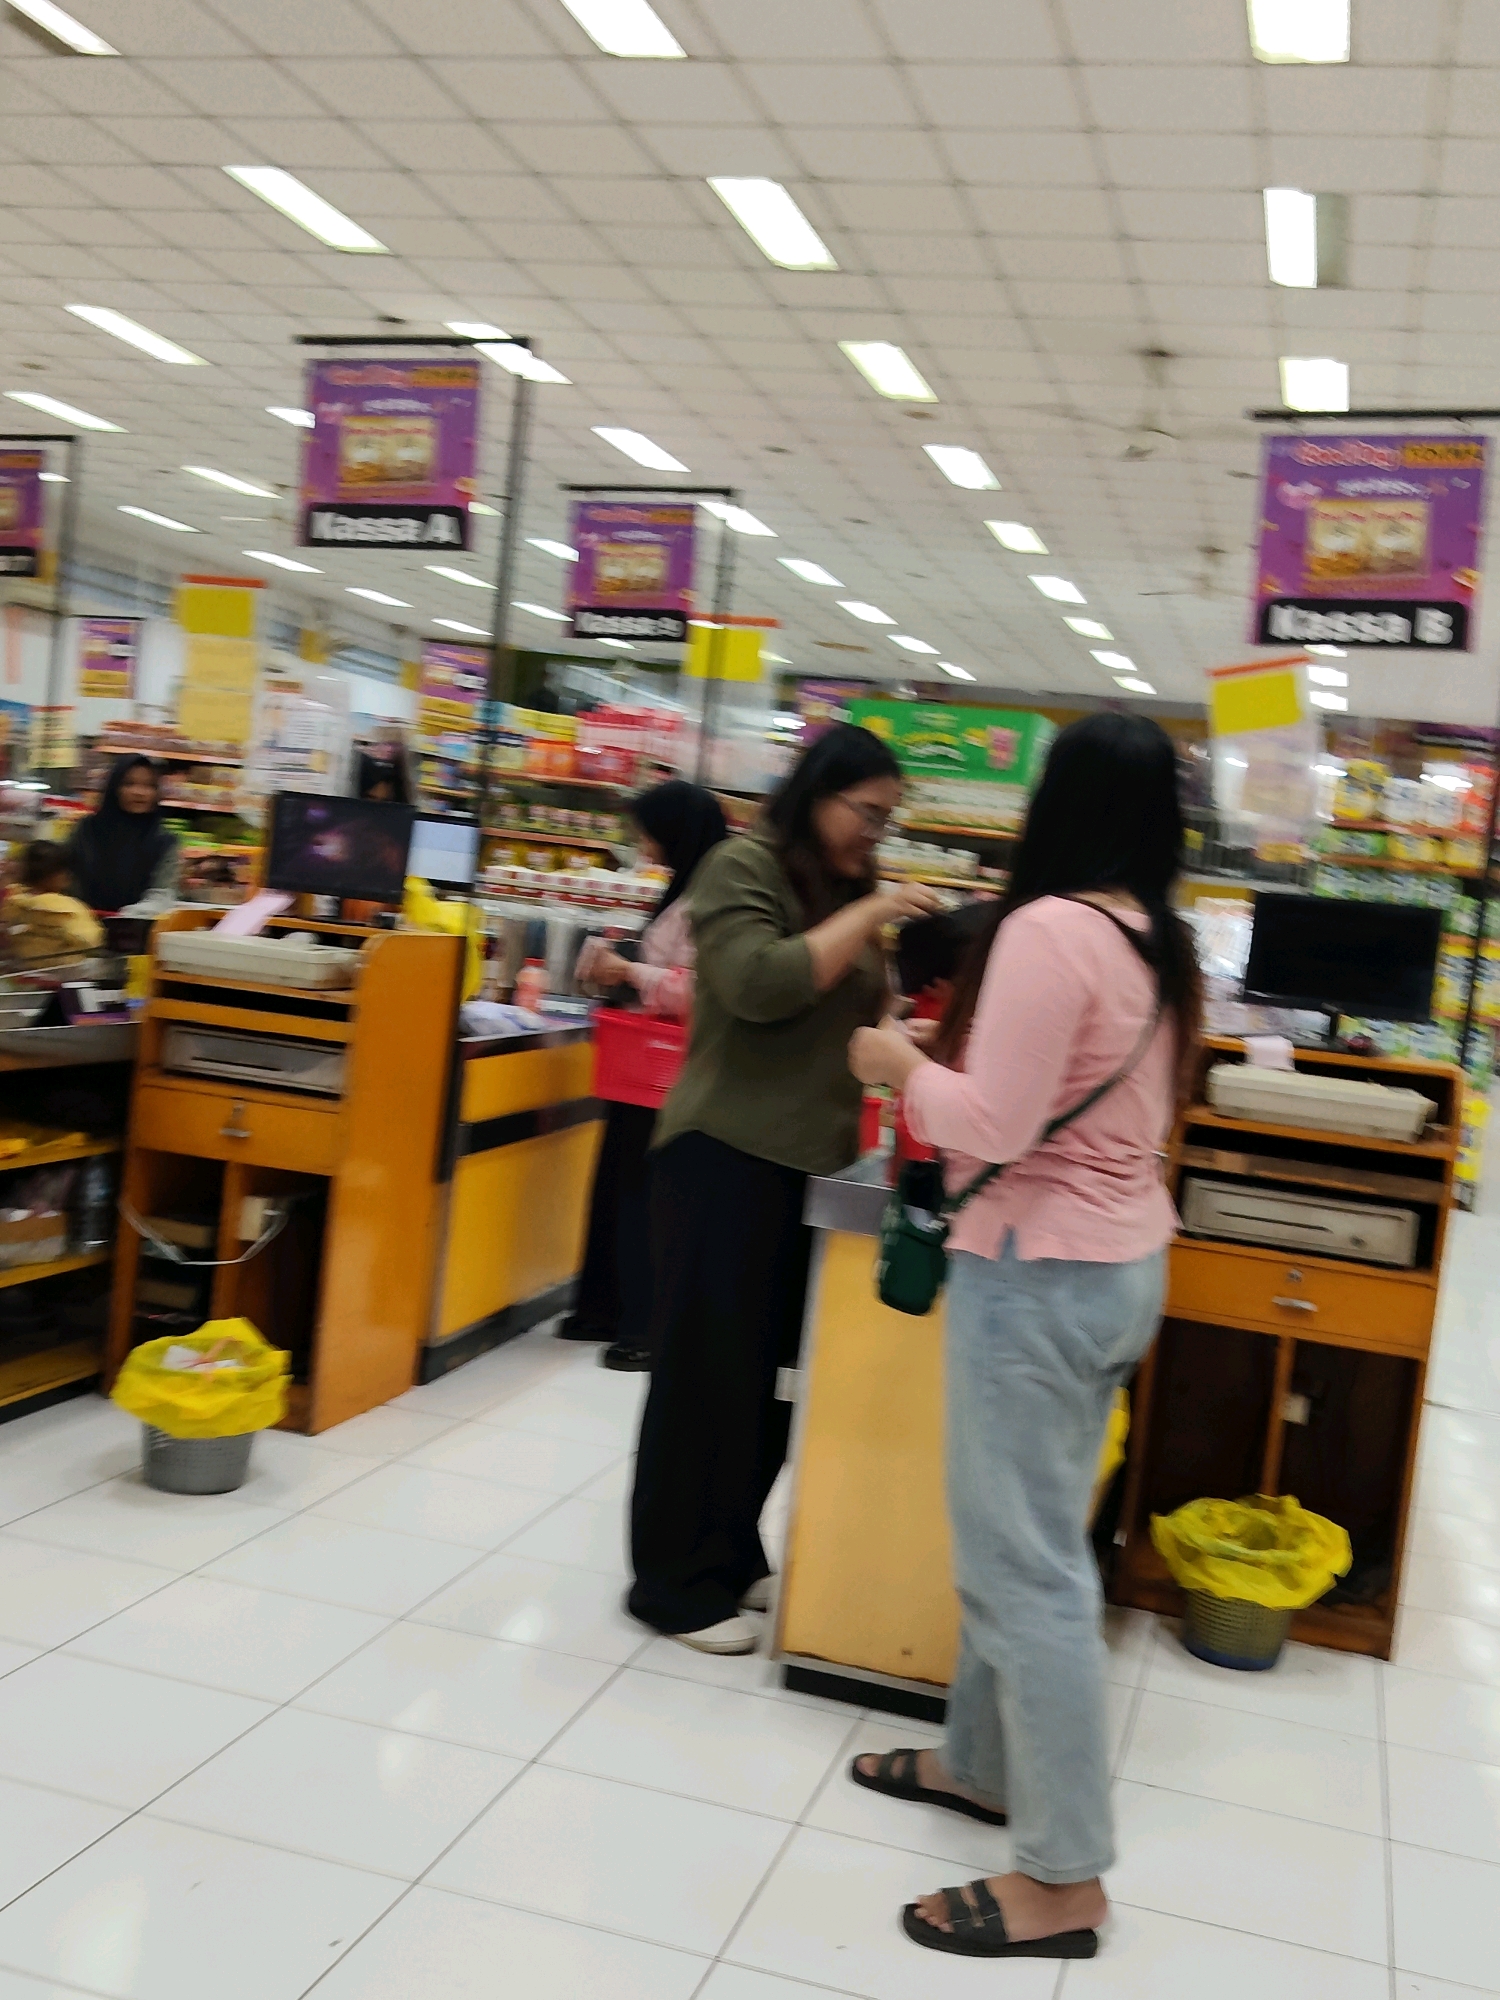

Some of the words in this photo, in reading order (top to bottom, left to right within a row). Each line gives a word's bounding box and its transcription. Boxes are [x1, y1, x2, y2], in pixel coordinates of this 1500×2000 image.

[313, 511, 424, 541] Kassa
[424, 513, 459, 544] A
[1270, 605, 1411, 644] Kassa
[1415, 608, 1453, 645] B
